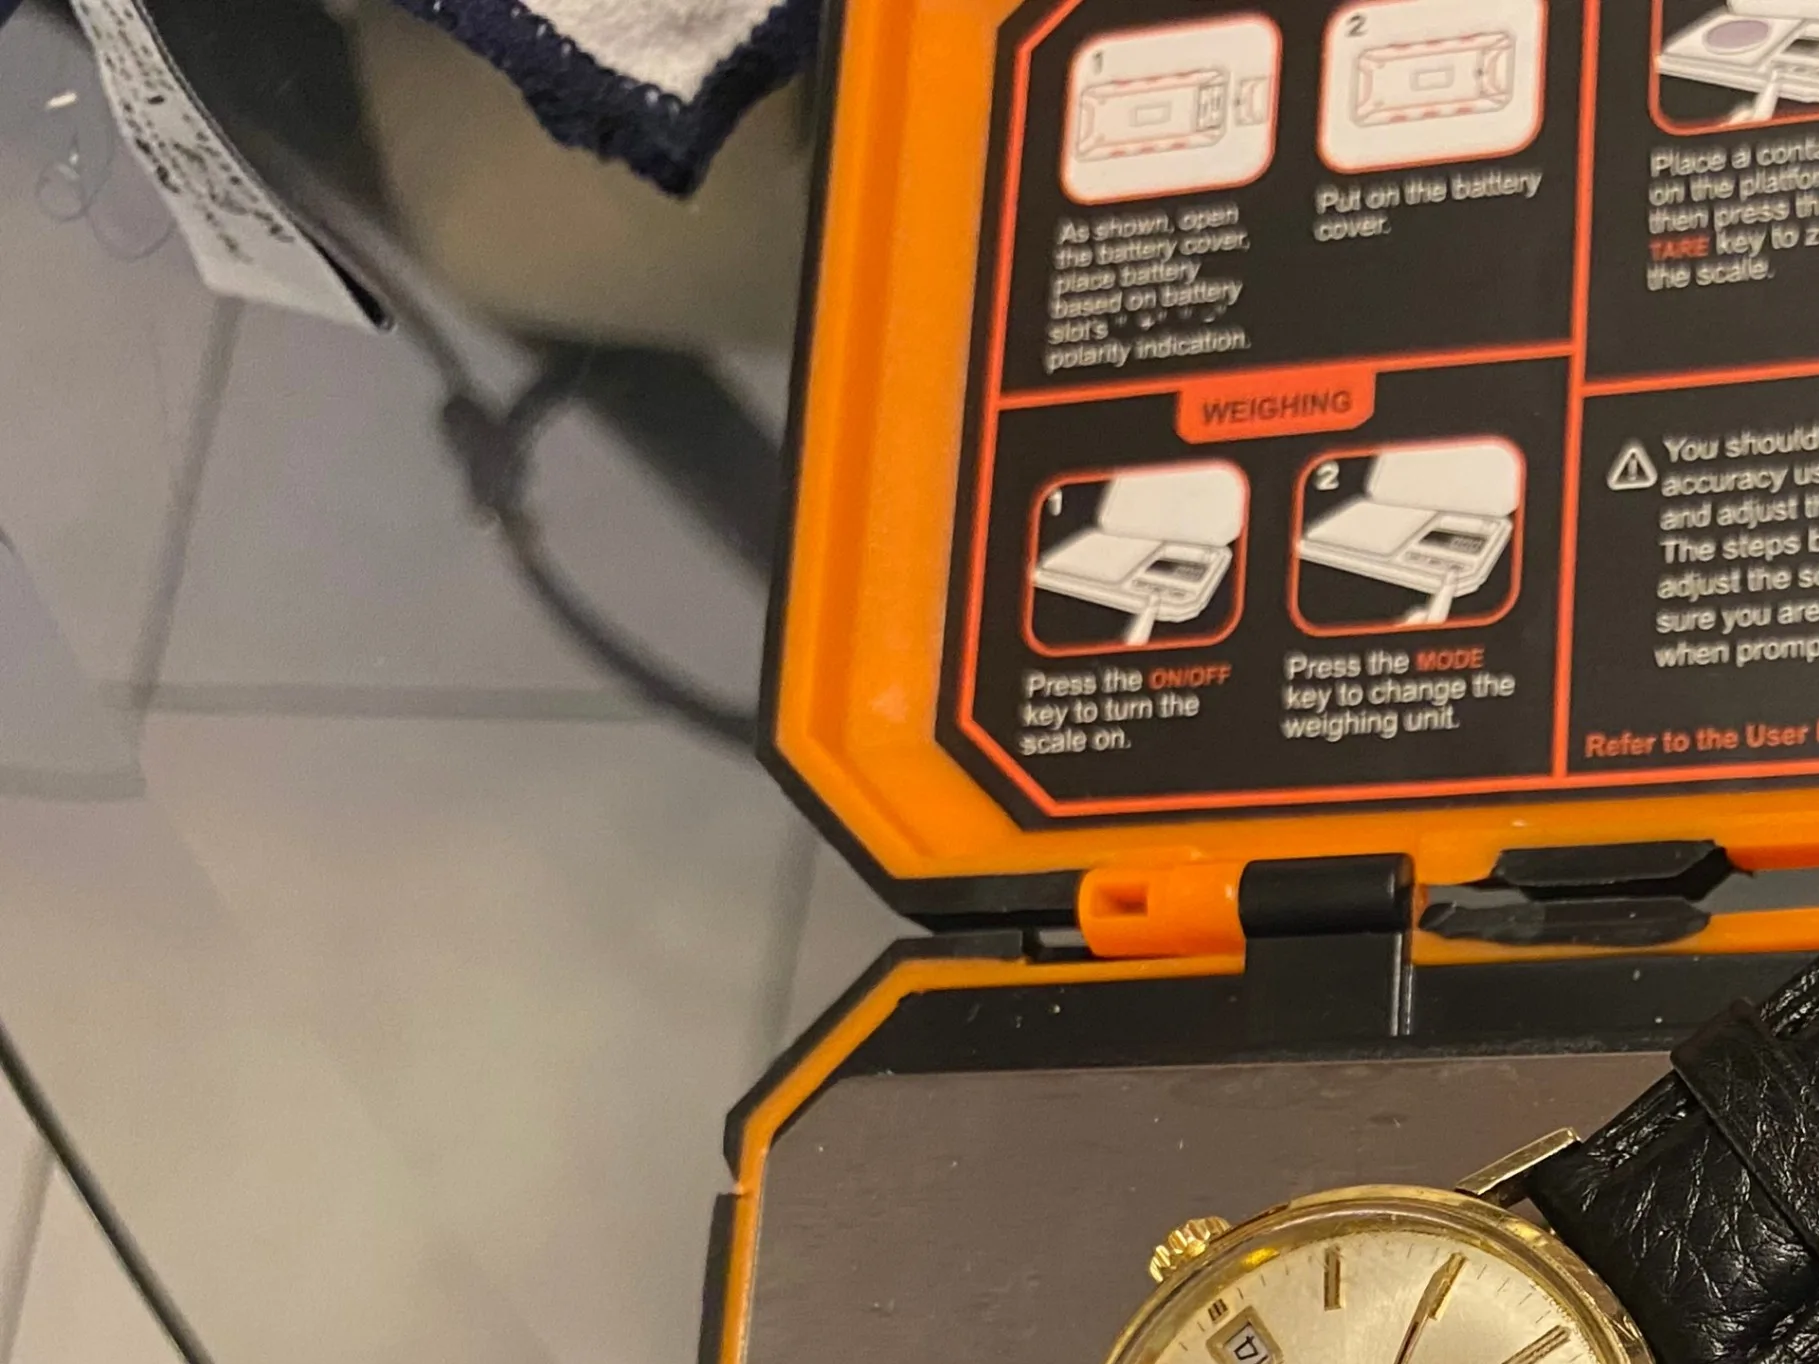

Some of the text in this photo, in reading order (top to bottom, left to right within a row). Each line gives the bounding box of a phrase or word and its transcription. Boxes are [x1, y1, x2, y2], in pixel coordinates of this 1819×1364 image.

[1344, 14, 1368, 38] 2
[1651, 152, 1726, 179] Place
[1732, 150, 1751, 170] a
[1317, 174, 1542, 216] Put on the battery
[1649, 185, 1685, 207] on
[1690, 176, 1734, 203] the
[1059, 223, 1090, 246] As
[1180, 209, 1239, 235] open
[1648, 209, 1709, 236] then
[1714, 202, 1790, 234] press
[1056, 246, 1093, 271] the
[1097, 240, 1177, 266] battery
[1716, 228, 1766, 259] key
[1771, 226, 1799, 250] to
[1053, 262, 1200, 302] place battery
[1647, 264, 1691, 292] the
[1051, 290, 1123, 321] based
[1128, 292, 1157, 312] on
[1162, 283, 1242, 308] battery
[1046, 341, 1131, 376] polarity
[1201, 389, 1353, 426] WEIGHING
[1664, 439, 1719, 464] You
[1314, 461, 1340, 491] 2
[1662, 468, 1787, 497] accuracy
[1046, 489, 1063, 516] 1
[1660, 502, 1712, 531] and
[1717, 496, 1798, 530] adjust
[1663, 537, 1715, 565] The
[1723, 535, 1801, 563] steps
[1658, 569, 1740, 604] adjust
[1747, 564, 1791, 593] the
[1657, 611, 1715, 634] sure
[1722, 606, 1771, 635] you
[1287, 642, 1483, 683] Press the MODE
[1654, 640, 1730, 668] when
[1026, 674, 1097, 700] Press
[1103, 667, 1143, 694] the
[1285, 672, 1515, 715] key to change the
[1023, 689, 1200, 733] key to turn the
[1284, 705, 1460, 743] weighing unit.
[1020, 726, 1131, 756] scale on.
[1586, 732, 1655, 760] Refer
[1663, 730, 1690, 754] to
[1696, 725, 1738, 752] the
[1746, 722, 1809, 749] User
